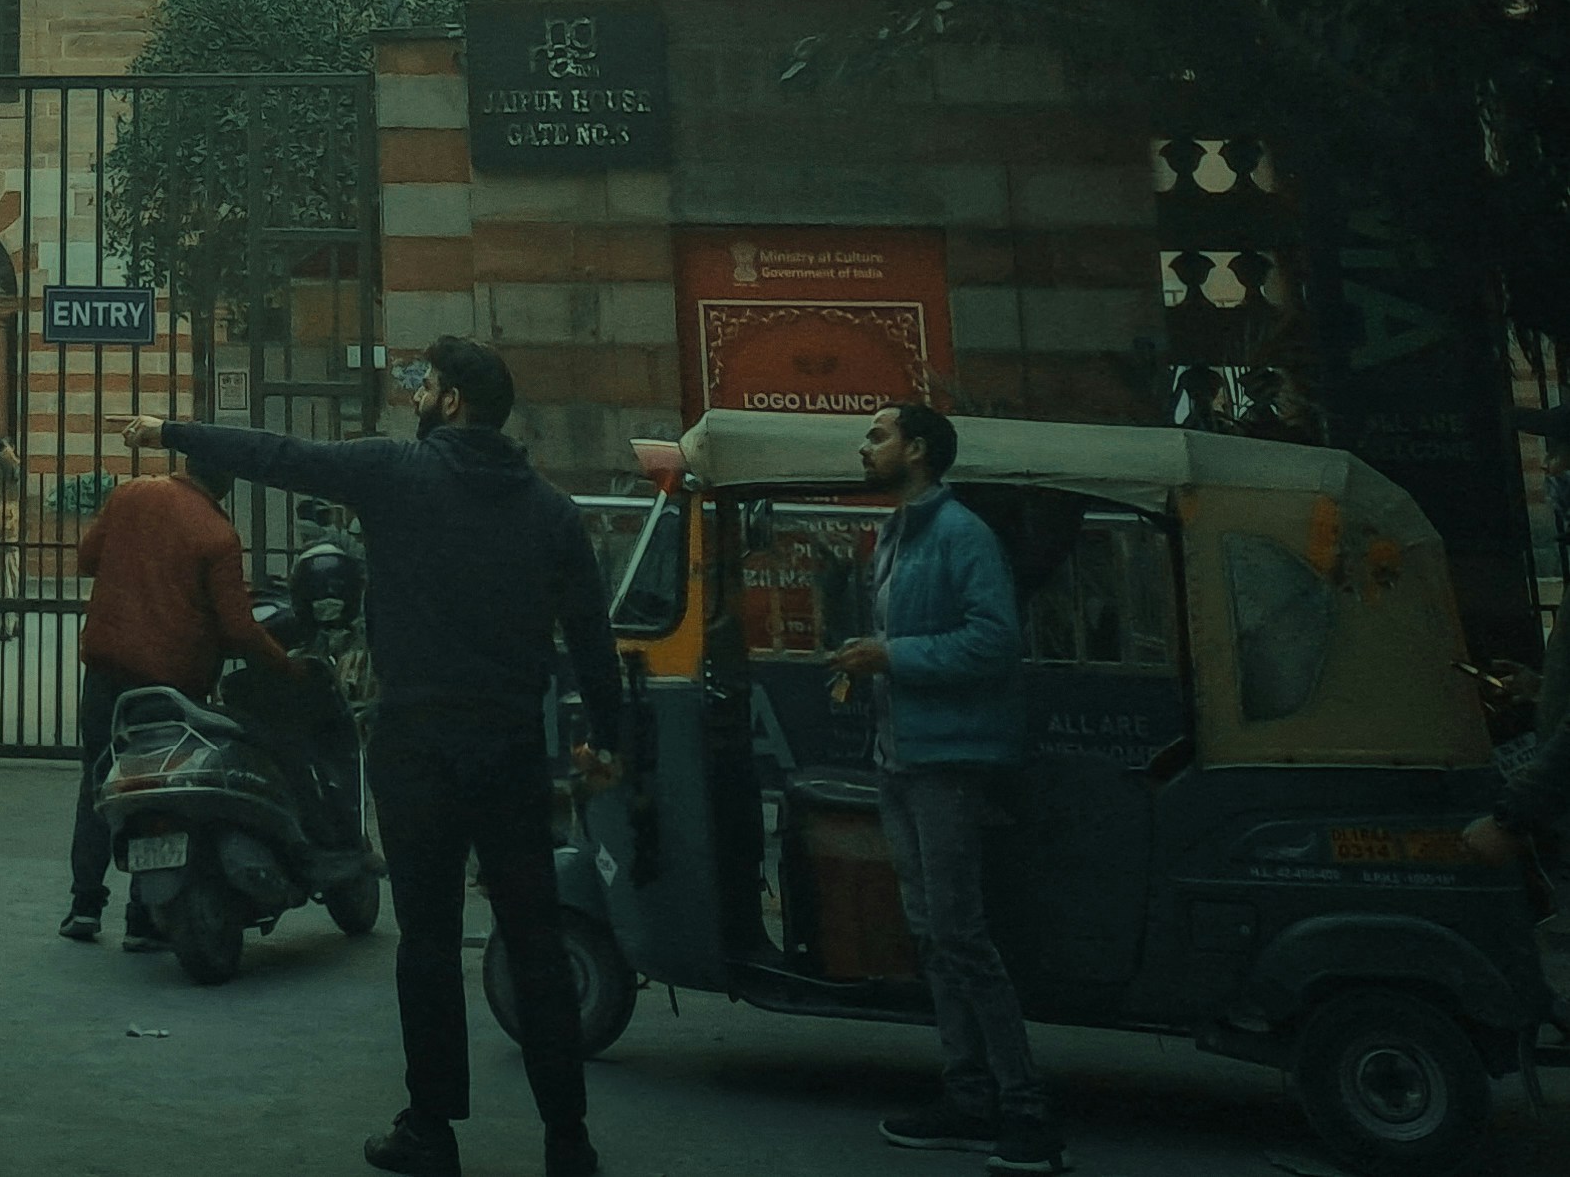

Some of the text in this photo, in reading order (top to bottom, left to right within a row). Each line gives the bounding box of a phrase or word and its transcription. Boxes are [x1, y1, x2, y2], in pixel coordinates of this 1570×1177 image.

[571, 89, 651, 113] HOUSE
[507, 122, 569, 146] GATE
[760, 250, 815, 264] Ministry
[835, 251, 884, 263] Culture
[761, 267, 883, 279] Government of India
[52, 300, 146, 327] ENTRY
[743, 392, 800, 410] LOGO
[1047, 713, 1151, 737] ALL ARE
